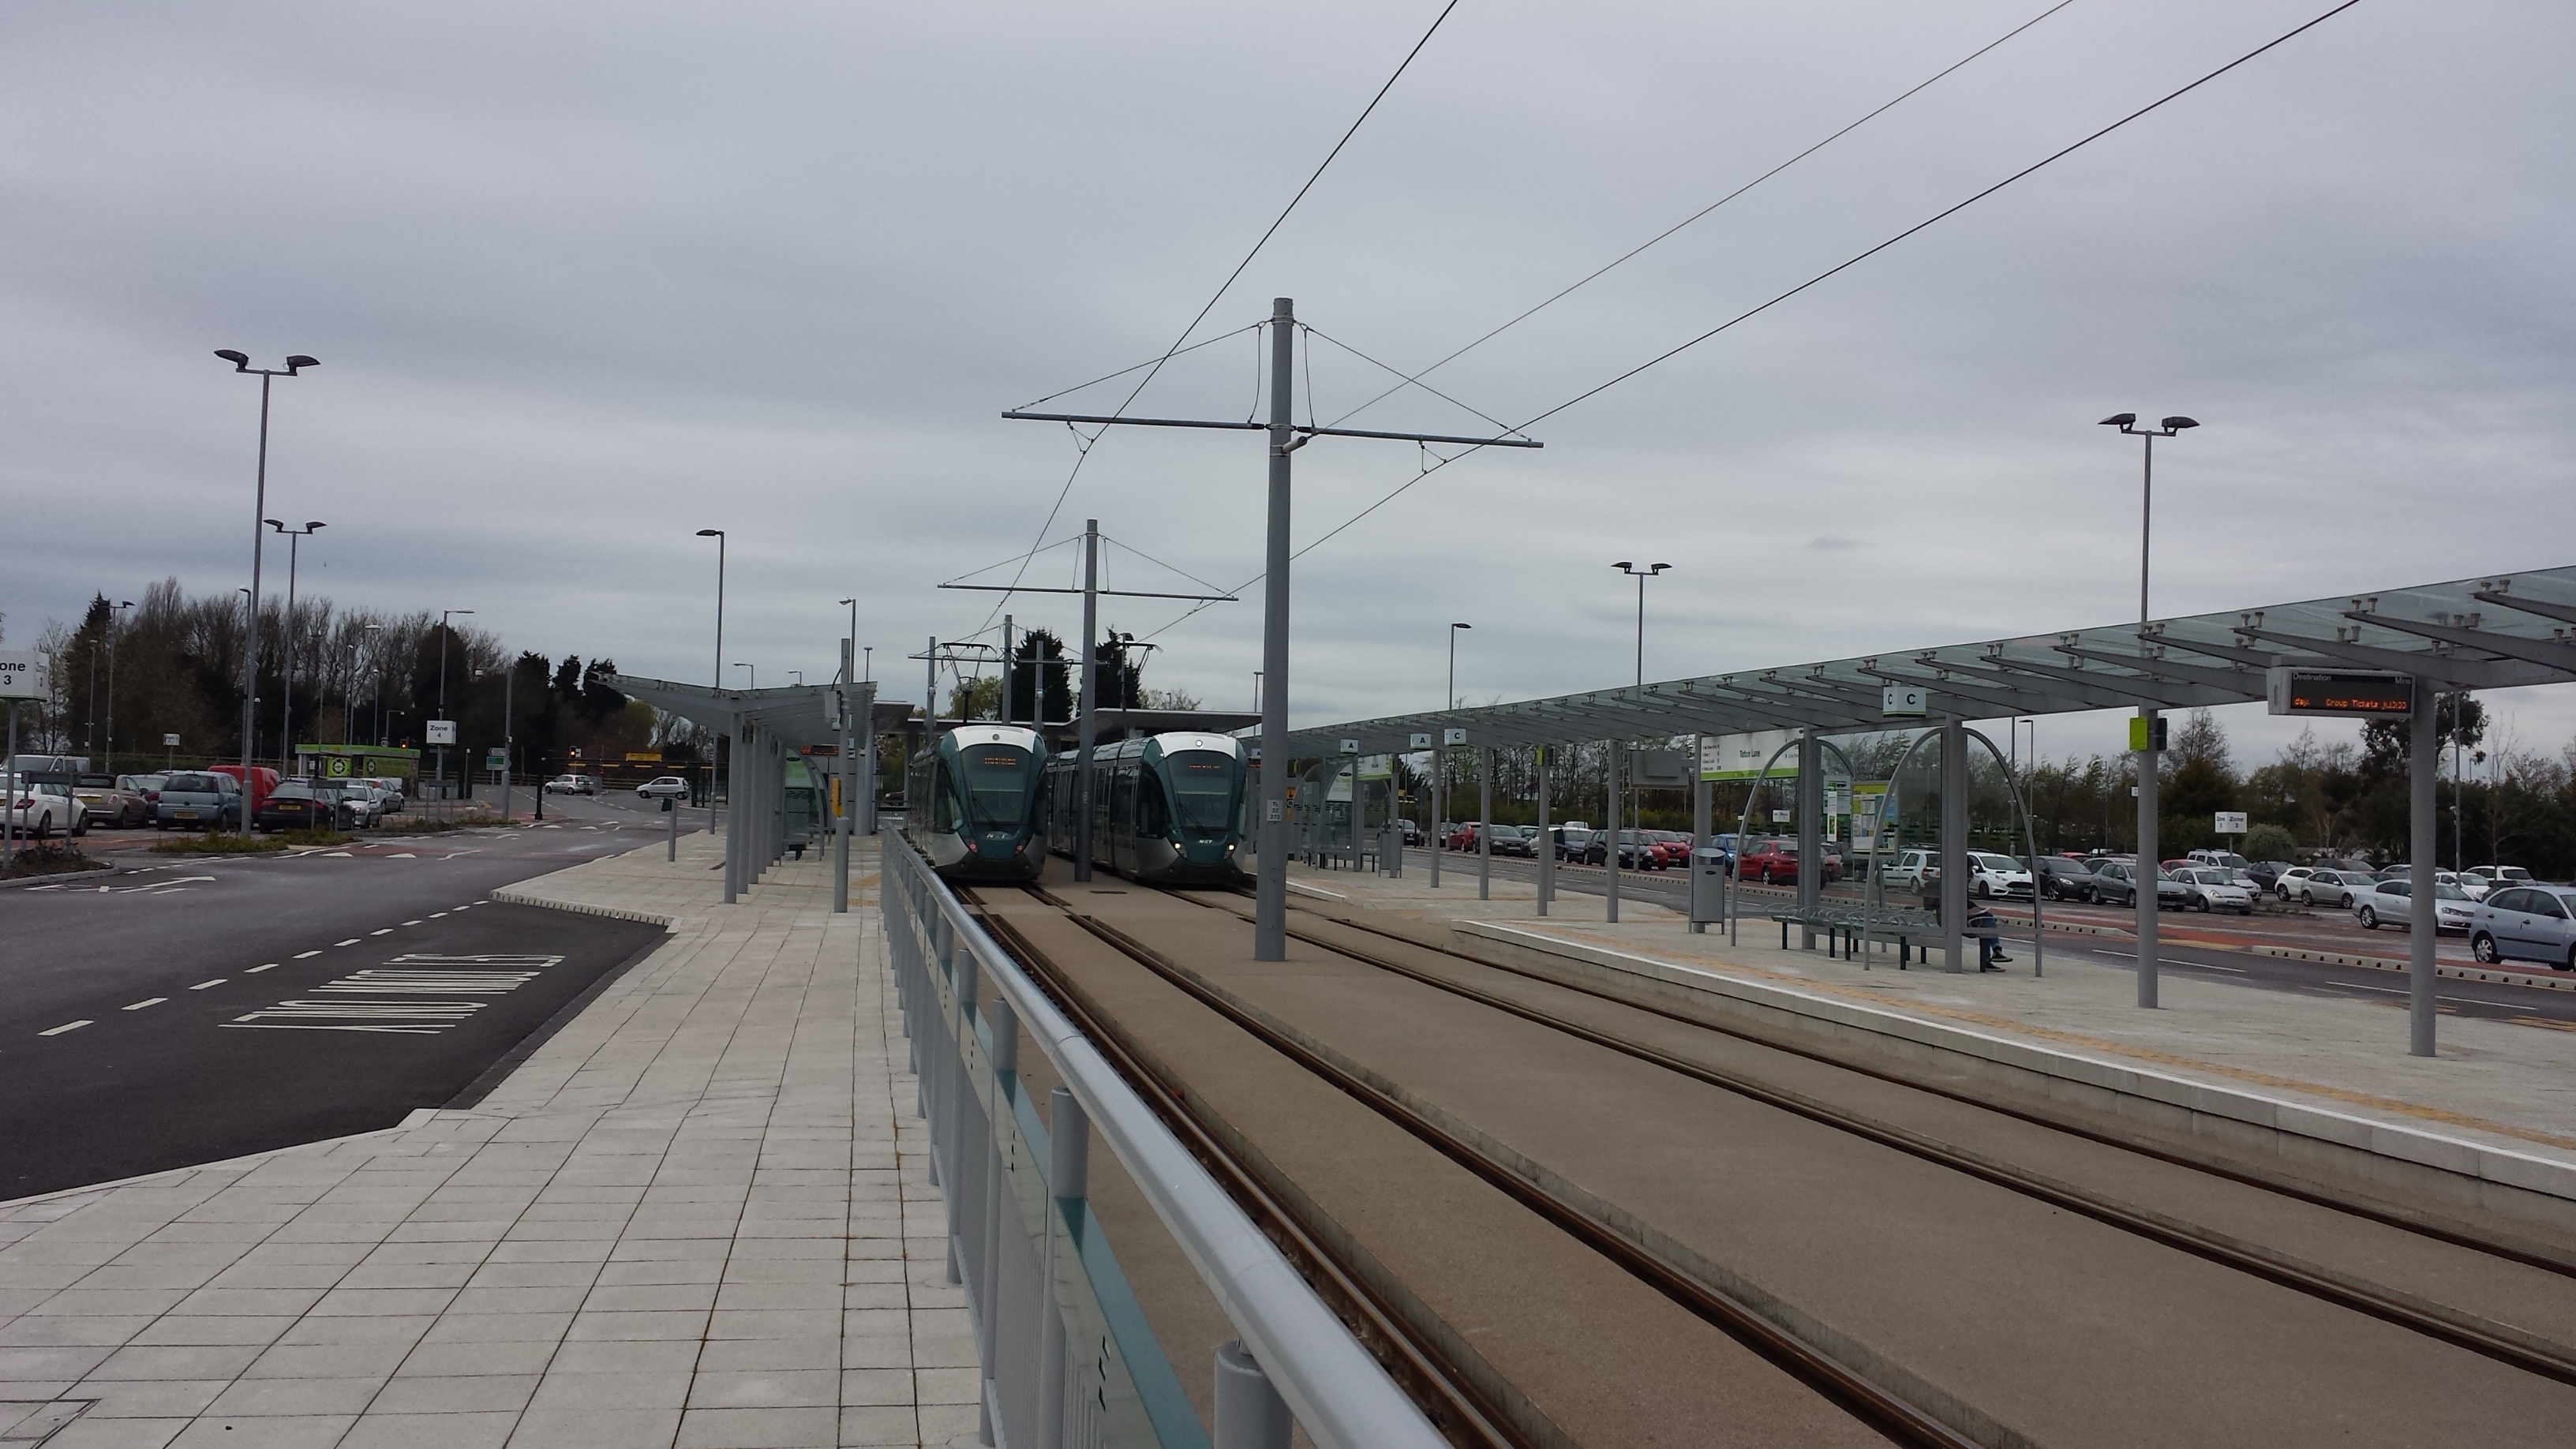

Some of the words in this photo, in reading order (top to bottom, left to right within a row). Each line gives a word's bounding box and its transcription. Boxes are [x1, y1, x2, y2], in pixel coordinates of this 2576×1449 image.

[4, 675, 12, 685] 3
[2293, 672, 2331, 682] Destination
[1888, 693, 1893, 705] C
[1906, 693, 1916, 705] C
[2326, 698, 2348, 708] Group
